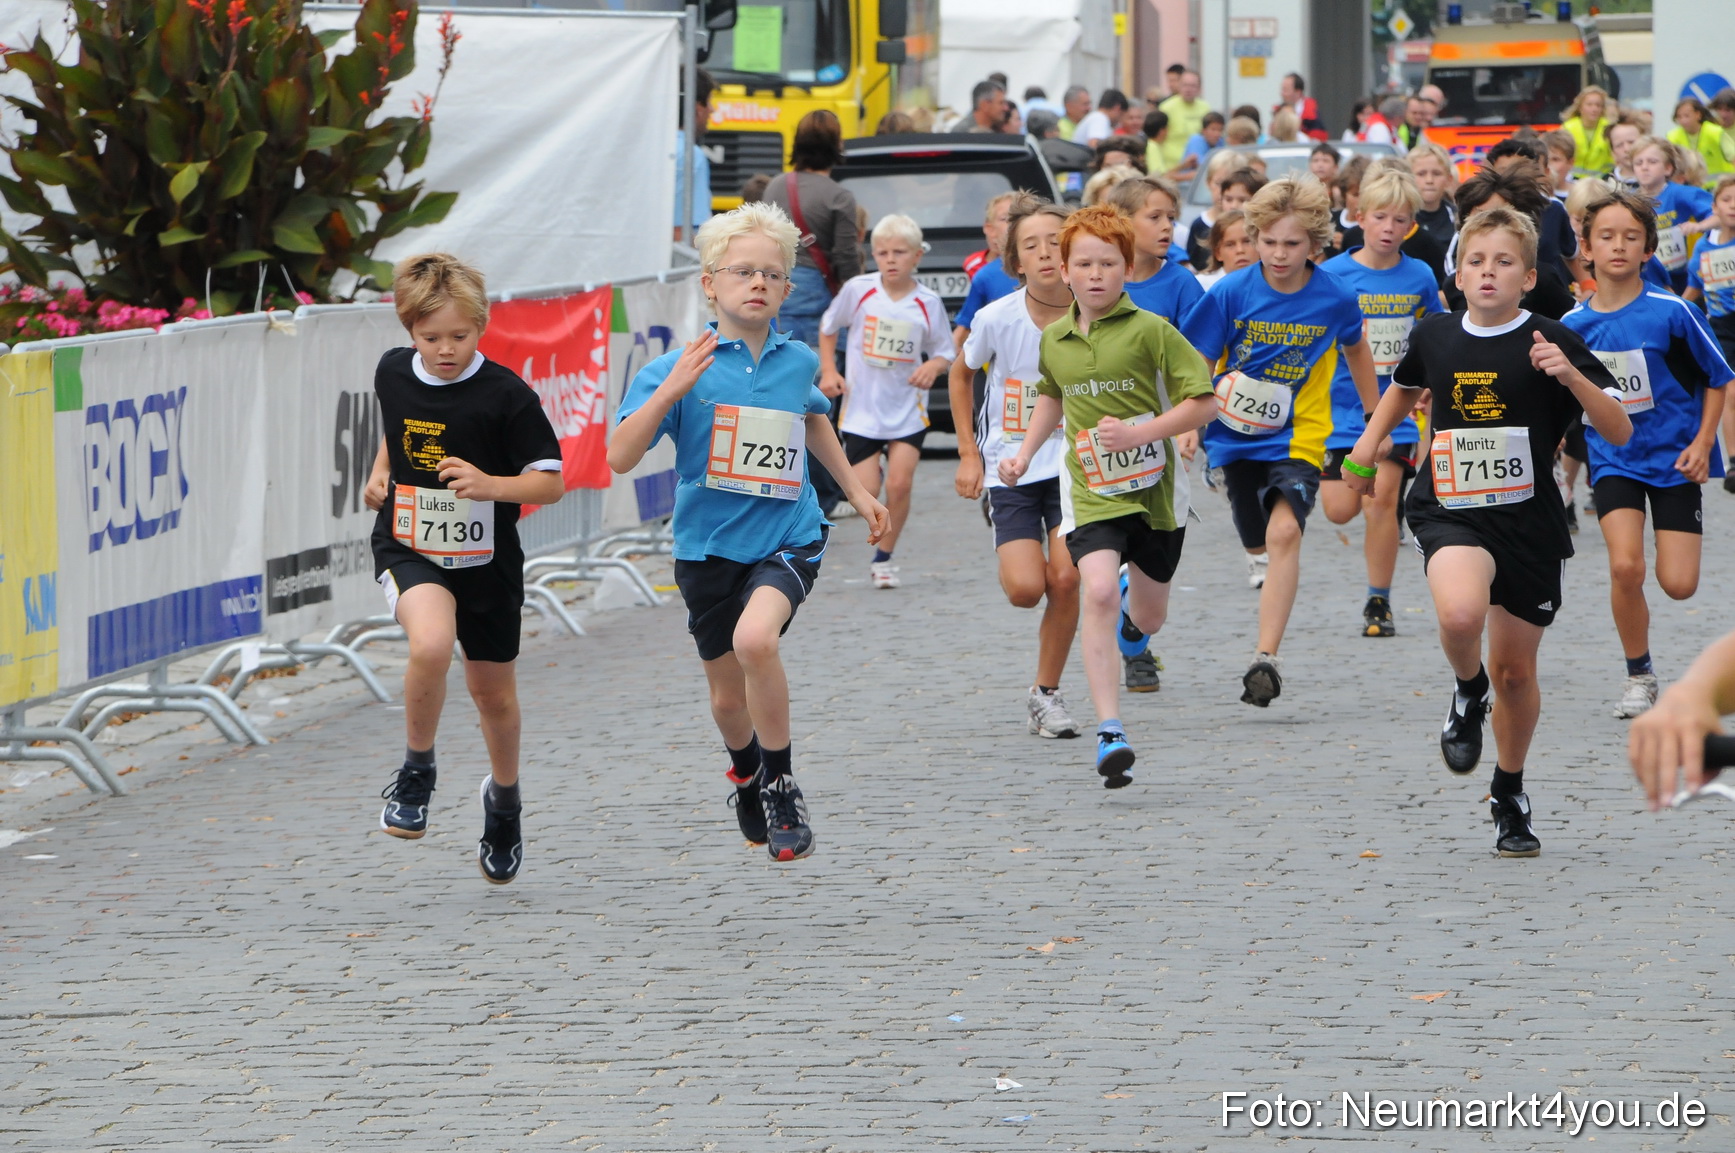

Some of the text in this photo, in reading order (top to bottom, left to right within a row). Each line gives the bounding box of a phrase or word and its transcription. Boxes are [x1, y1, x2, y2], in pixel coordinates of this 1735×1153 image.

[711, 102, 781, 124] Müller
[1658, 242, 1681, 257] 134
[1360, 305, 1412, 315] TADTLAUF
[1371, 324, 1407, 335] JULIAN
[878, 336, 914, 354] 7123
[1246, 330, 1313, 346] STADTLAUF
[1617, 375, 1642, 392] 30
[1233, 391, 1281, 420] 7249
[403, 418, 446, 430] NEUMARKTER
[406, 425, 442, 436] STADTLAUF
[1456, 436, 1496, 451] Moritz
[742, 442, 798, 471] 7237
[1101, 443, 1158, 472] 7024
[84, 386, 189, 554] BOCK
[1436, 460, 1449, 472] K6
[1460, 457, 1524, 481] 7158
[1497, 488, 1533, 499] PFLEIDERER
[419, 494, 455, 512] Lukas
[397, 515, 410, 528] K6
[421, 520, 484, 543] 7130
